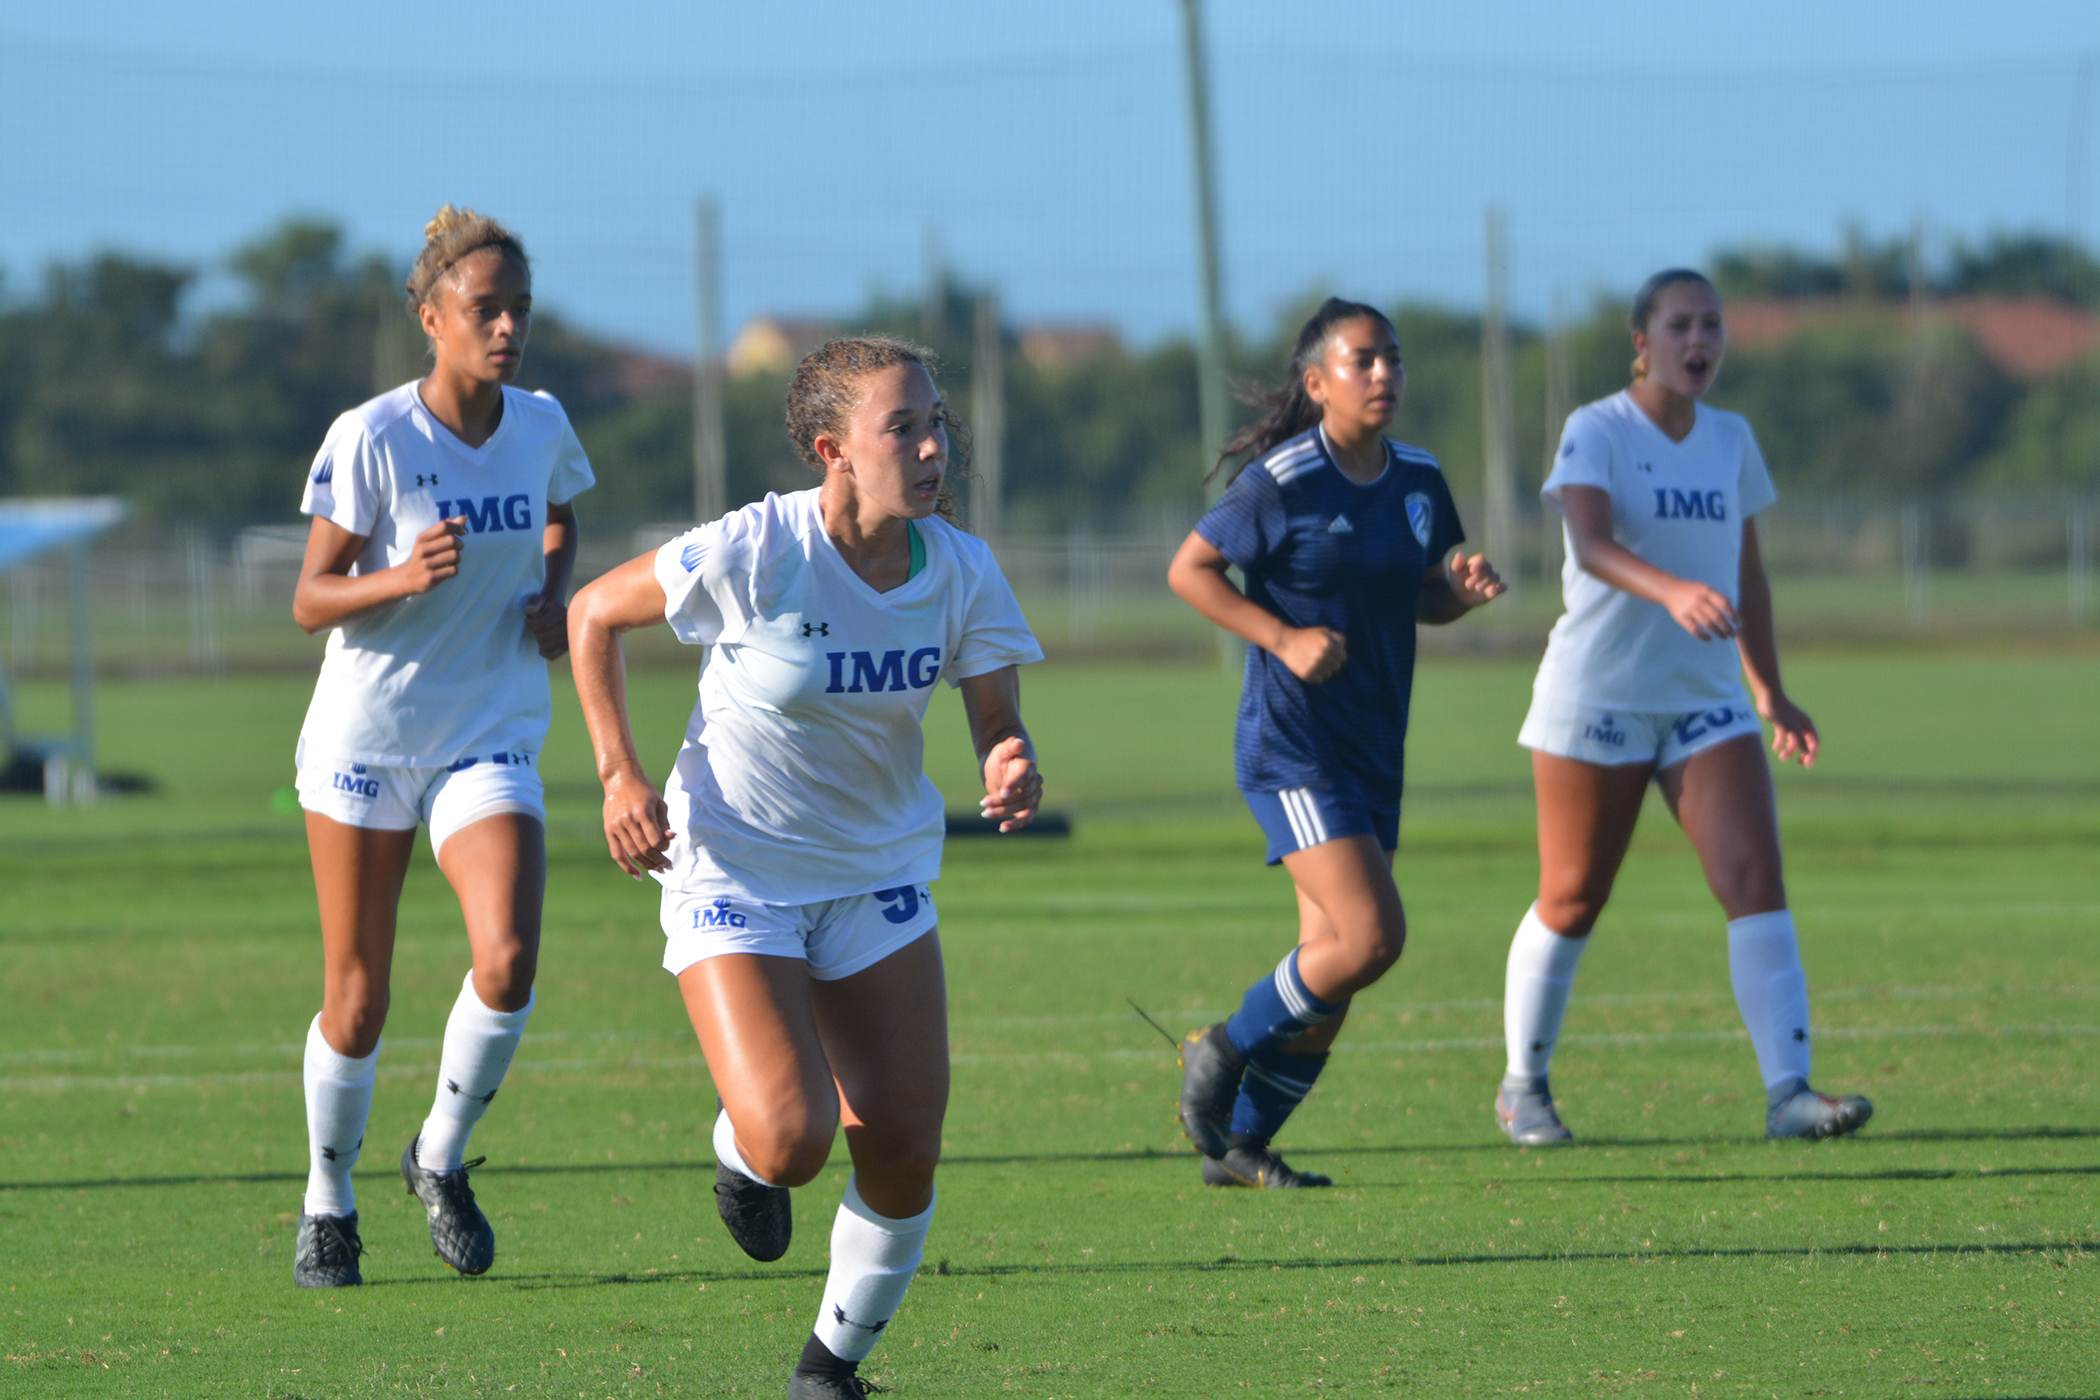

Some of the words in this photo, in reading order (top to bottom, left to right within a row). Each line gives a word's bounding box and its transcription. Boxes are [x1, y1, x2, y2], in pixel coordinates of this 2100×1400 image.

[435, 494, 531, 533] IMG
[1653, 488, 1726, 522] IMG
[825, 647, 940, 693] IMG
[333, 771, 380, 798] IMG
[692, 908, 746, 929] IMG
